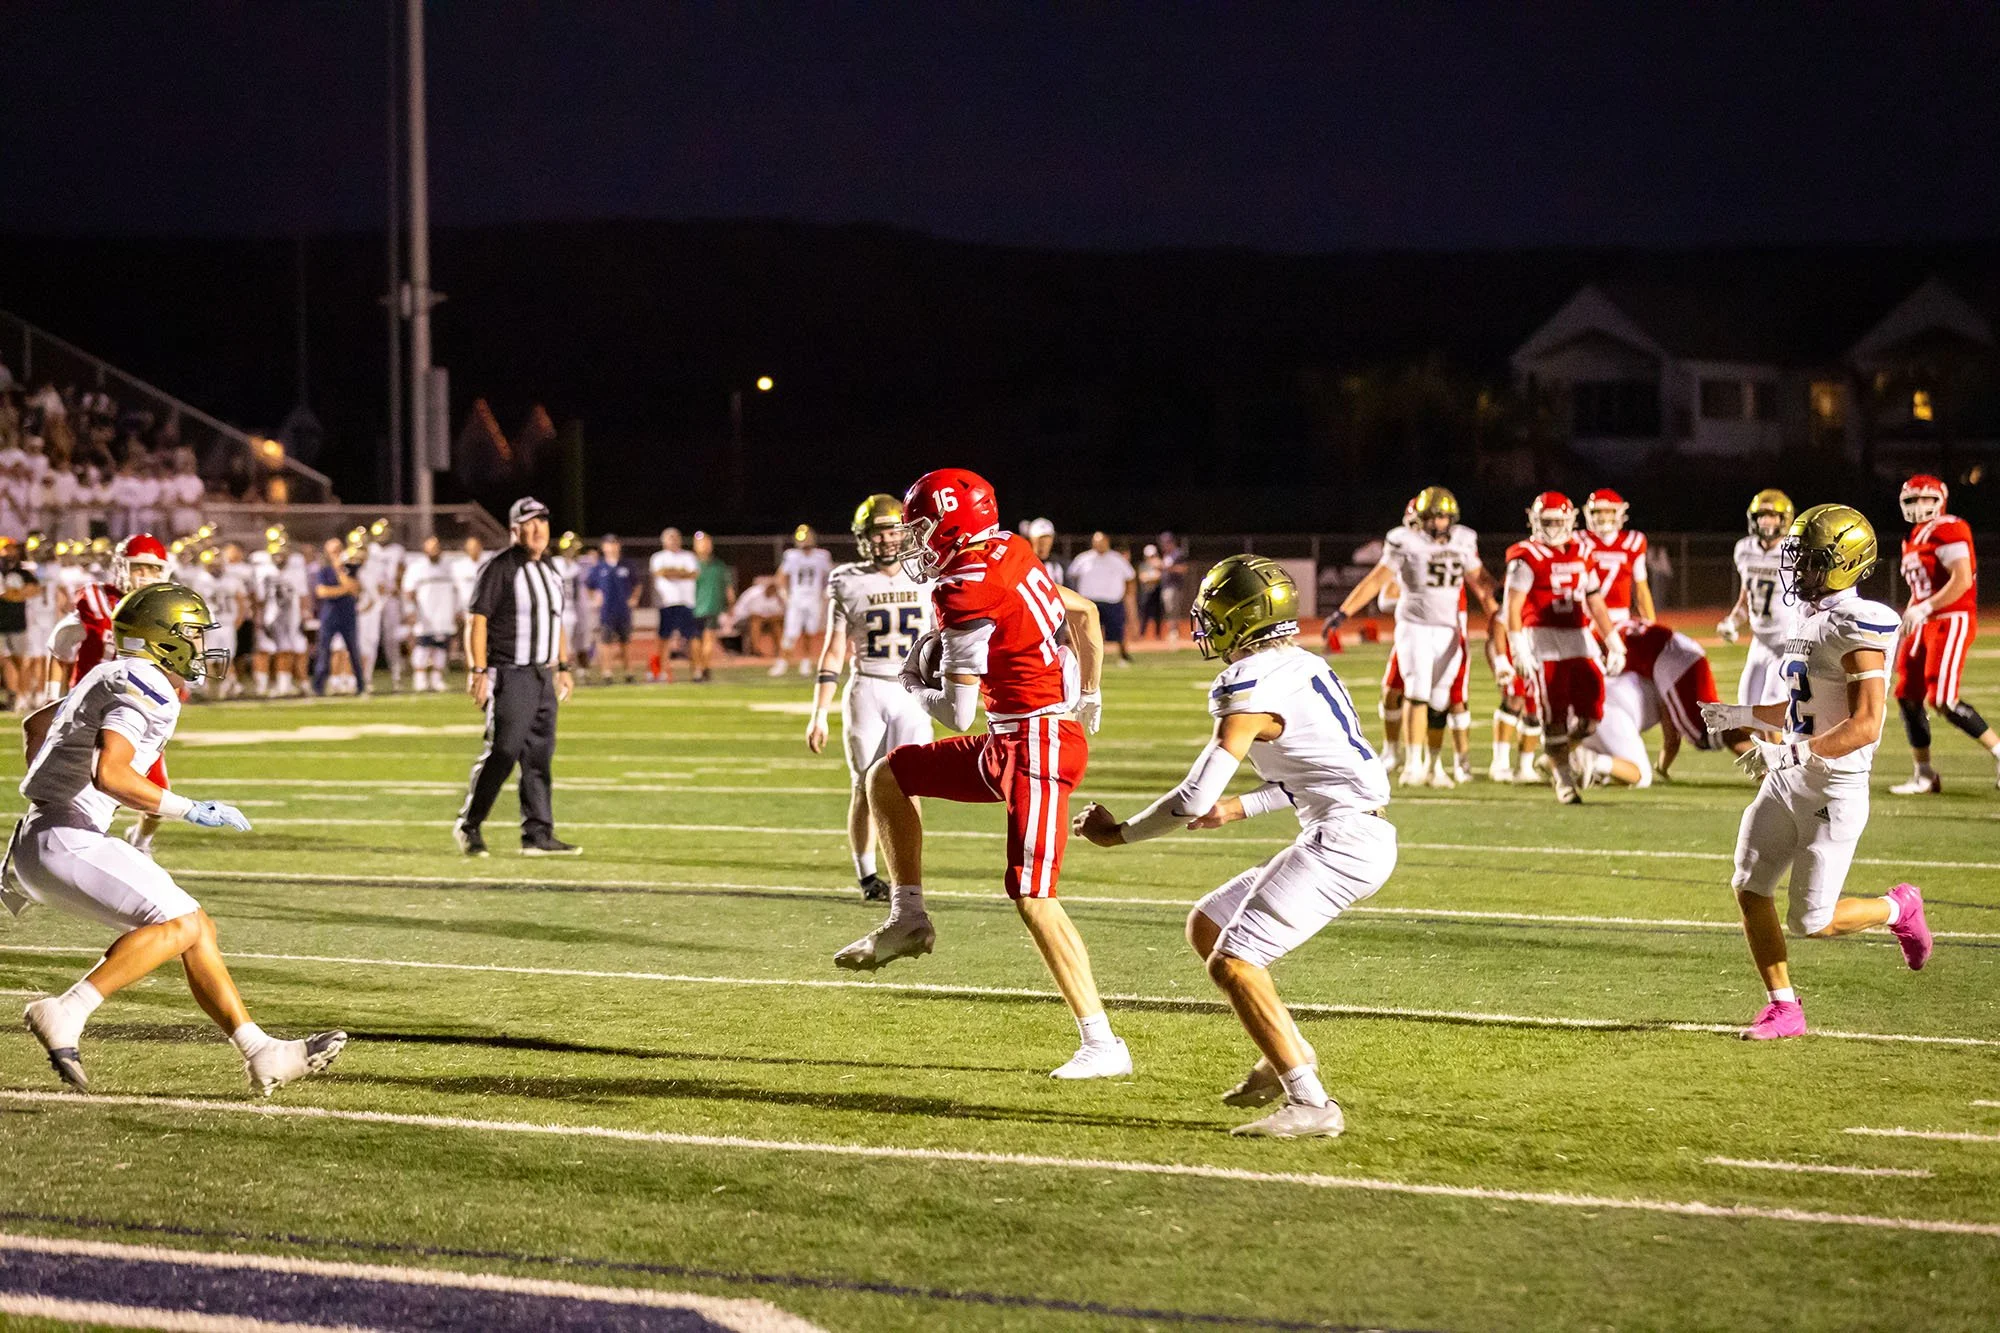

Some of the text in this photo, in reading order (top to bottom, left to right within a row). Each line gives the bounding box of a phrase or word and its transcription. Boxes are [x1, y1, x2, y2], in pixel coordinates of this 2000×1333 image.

[932, 487, 959, 513] 16
[866, 591, 918, 606] WARRIORS
[1016, 566, 1066, 667] 16
[866, 607, 923, 658] 25
